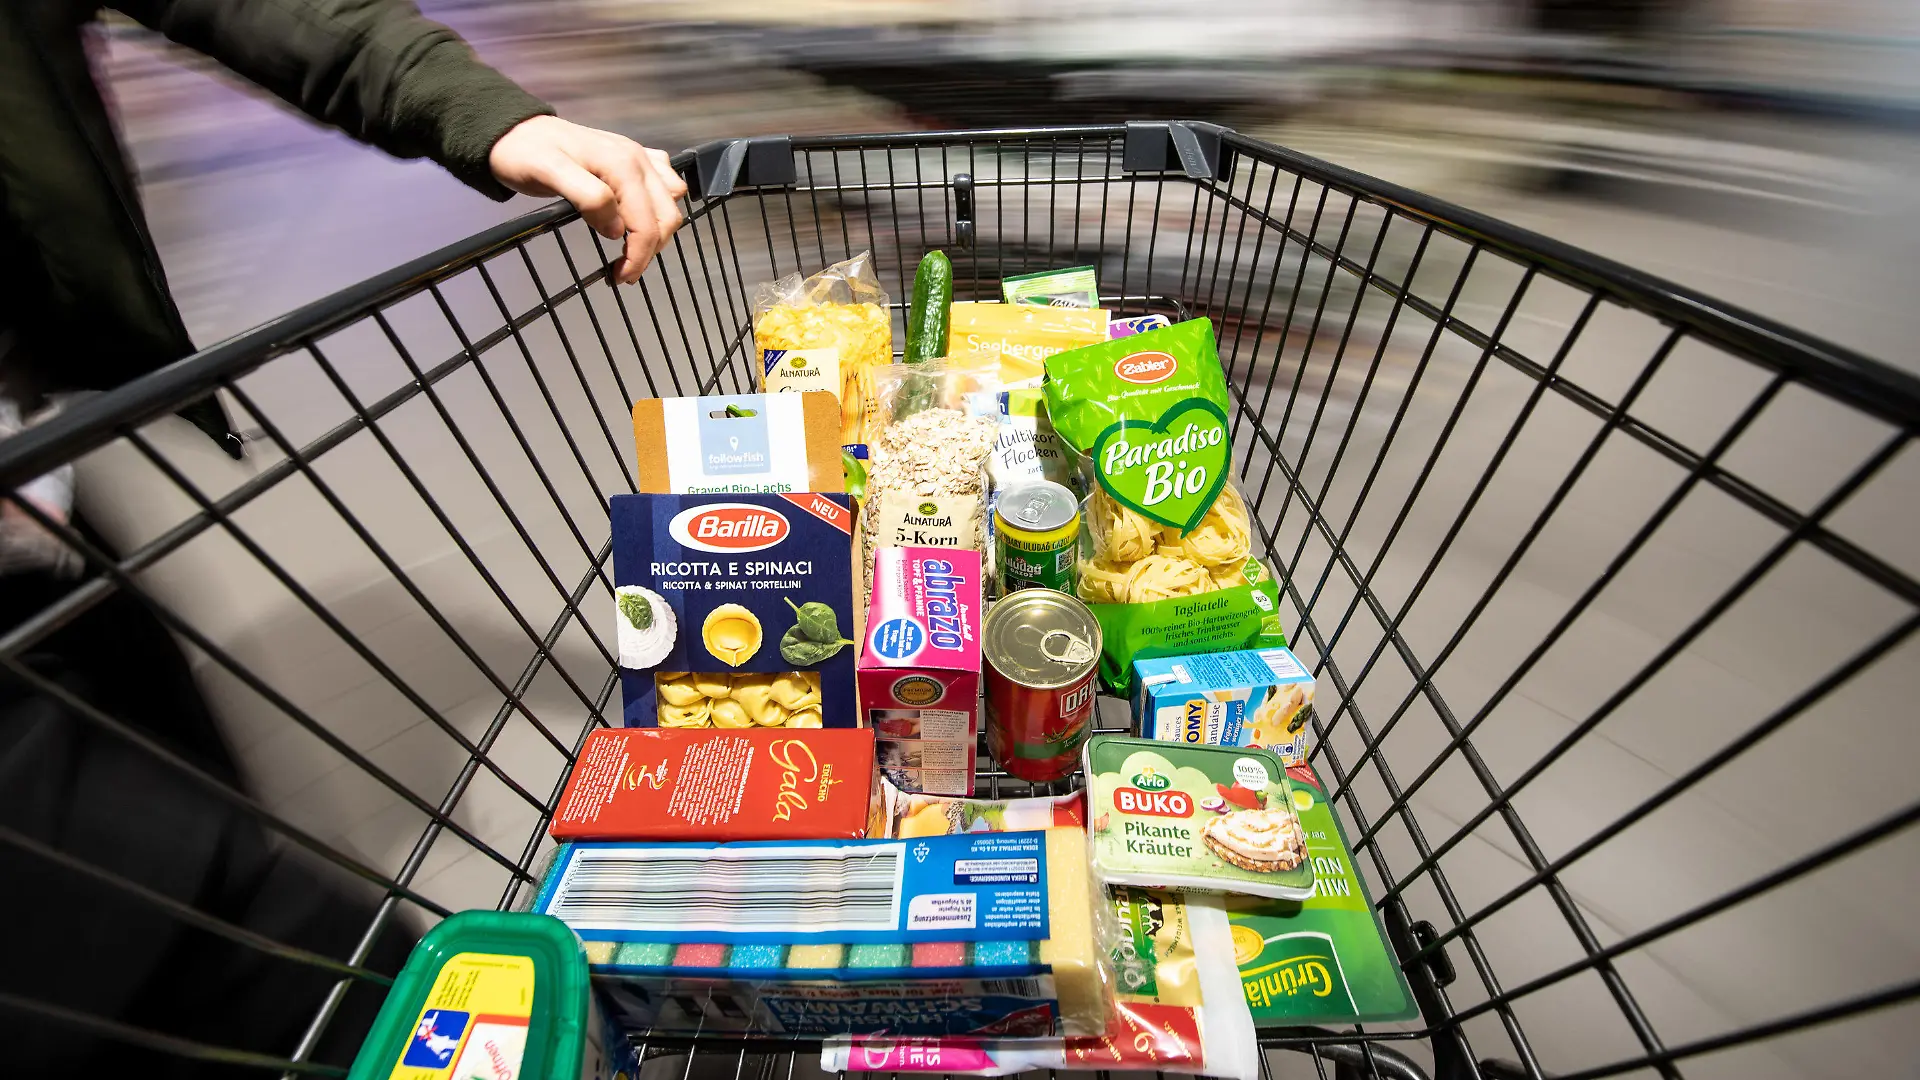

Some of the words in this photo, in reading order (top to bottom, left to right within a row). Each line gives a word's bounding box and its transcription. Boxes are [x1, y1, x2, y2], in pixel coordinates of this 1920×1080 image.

[967, 334, 1064, 360] Seeberger
[780, 367, 821, 378] ALNATURA
[993, 429, 1055, 452] Multikor
[1105, 423, 1222, 475] Paradiso
[708, 452, 764, 464] followfish
[1001, 445, 1059, 469] Flocken
[688, 485, 729, 494] Graved
[732, 482, 792, 494] Bio-Lachs
[1142, 460, 1206, 506] Bio
[810, 498, 839, 520] NEU
[697, 515, 780, 538] Barilla
[903, 512, 952, 527] ALNATURA
[895, 527, 958, 546] 5-Korn
[650, 562, 721, 576] RICOTTA
[729, 562, 738, 576] E
[745, 560, 812, 575] SPINACI
[662, 580, 701, 590] RICOTTA
[704, 580, 712, 590] &
[715, 580, 748, 590] SPINAT
[750, 579, 801, 590] TORTELLINI
[922, 559, 966, 650] abrazo
[1173, 597, 1229, 617] Tagliatelle
[1163, 623, 1187, 633] reiner
[1165, 630, 1195, 642] frisches
[1196, 621, 1241, 636] Trinkwasser
[1173, 639, 1189, 648] und
[1190, 636, 1210, 646] sonst
[1186, 702, 1203, 743] OMY
[1207, 704, 1221, 746] landaise
[769, 739, 818, 823] Gala
[817, 763, 831, 802] EDUSCHO
[1136, 773, 1165, 788] Arla
[1120, 791, 1188, 814] BUKO
[1124, 821, 1190, 840] Pikante
[1126, 839, 1192, 858] Kräuter
[1311, 857, 1345, 875] NU
[1314, 878, 1351, 897] MIL
[914, 914, 971, 922] Zusammensetzung:
[1243, 961, 1333, 1007] Grünlä
[1134, 1032, 1155, 1053] 6
